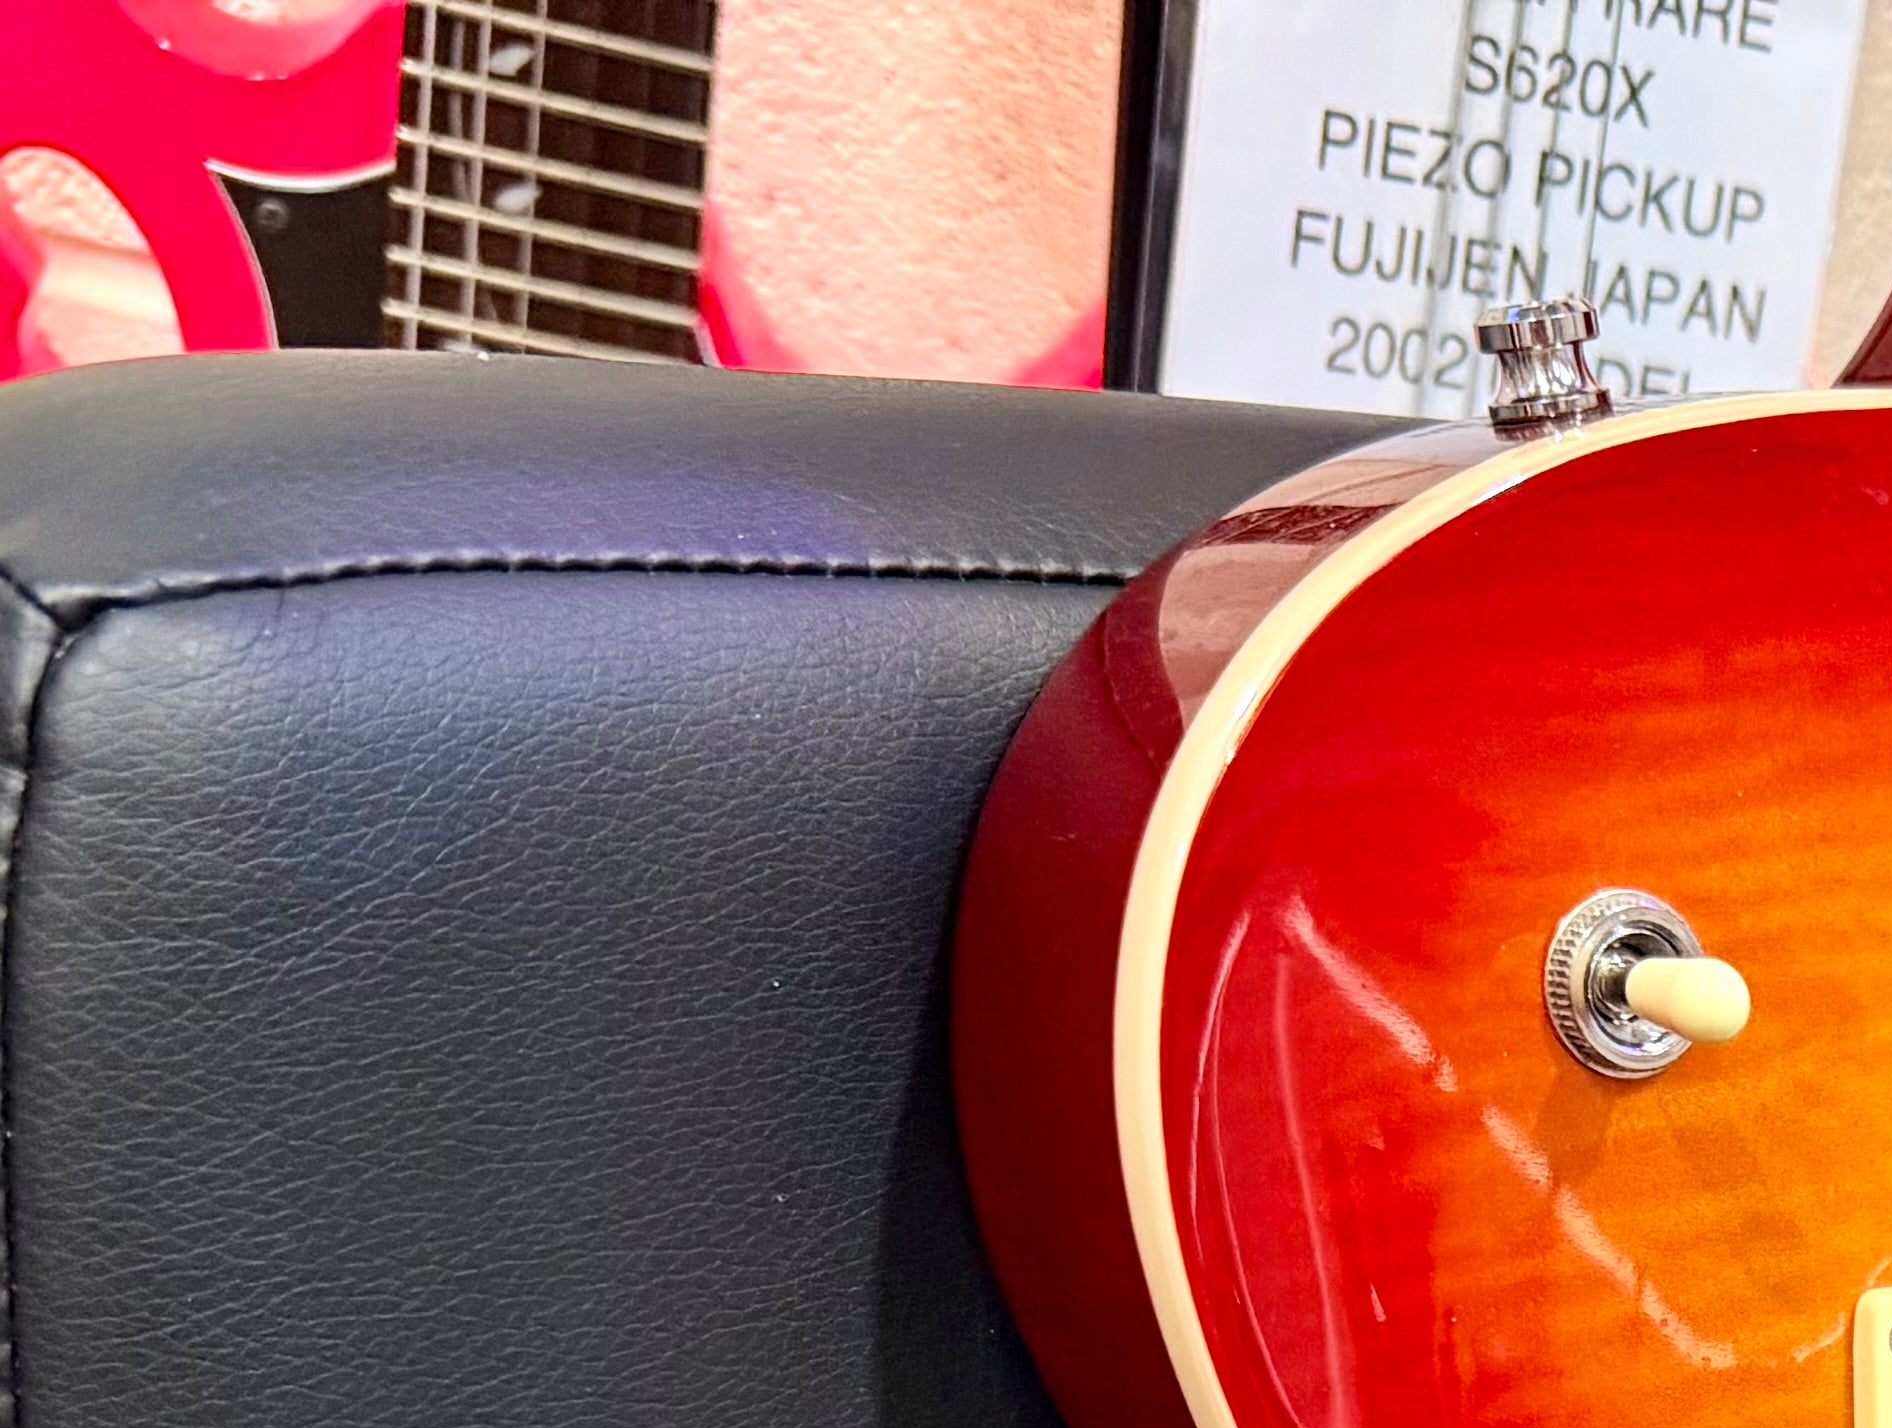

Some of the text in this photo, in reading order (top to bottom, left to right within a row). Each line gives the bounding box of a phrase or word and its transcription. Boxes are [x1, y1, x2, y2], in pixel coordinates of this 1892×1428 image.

[1465, 34, 1655, 128] S620X
[1318, 108, 1766, 243] PIEZO PICKUP
[1291, 209, 1549, 301] FUJIJEN
[1326, 317, 1469, 390] 2002
